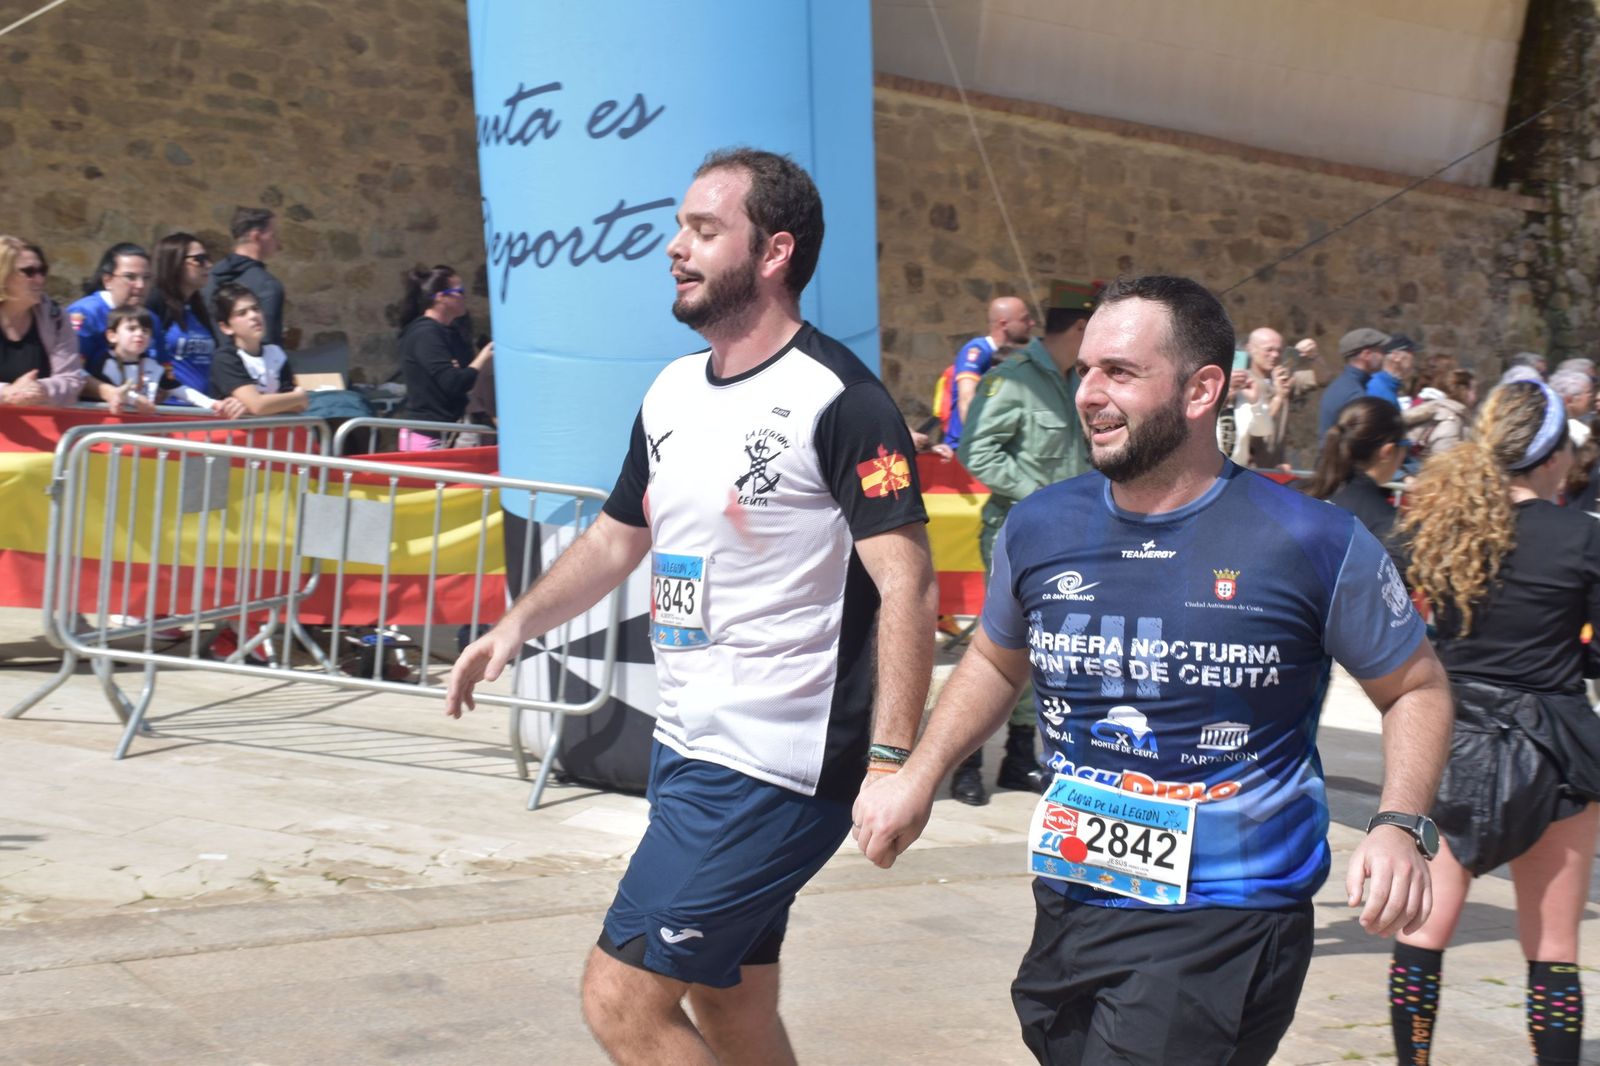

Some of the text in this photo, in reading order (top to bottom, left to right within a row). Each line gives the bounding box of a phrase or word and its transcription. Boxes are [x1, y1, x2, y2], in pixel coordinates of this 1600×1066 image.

[584, 92, 666, 140] es
[737, 495, 768, 507] CEUTA
[655, 577, 695, 615] 2843
[1065, 594, 1095, 602] URBANO
[1246, 604, 1264, 612] Ceuta
[1131, 638, 1281, 664] NOCTURNA
[1129, 660, 1170, 684] DE
[1178, 663, 1280, 689] CEUTA
[1061, 731, 1075, 744] AL
[1091, 739, 1159, 760] MONTES DE CEUTA
[1050, 782, 1066, 799] X
[1086, 817, 1177, 870] 2842
